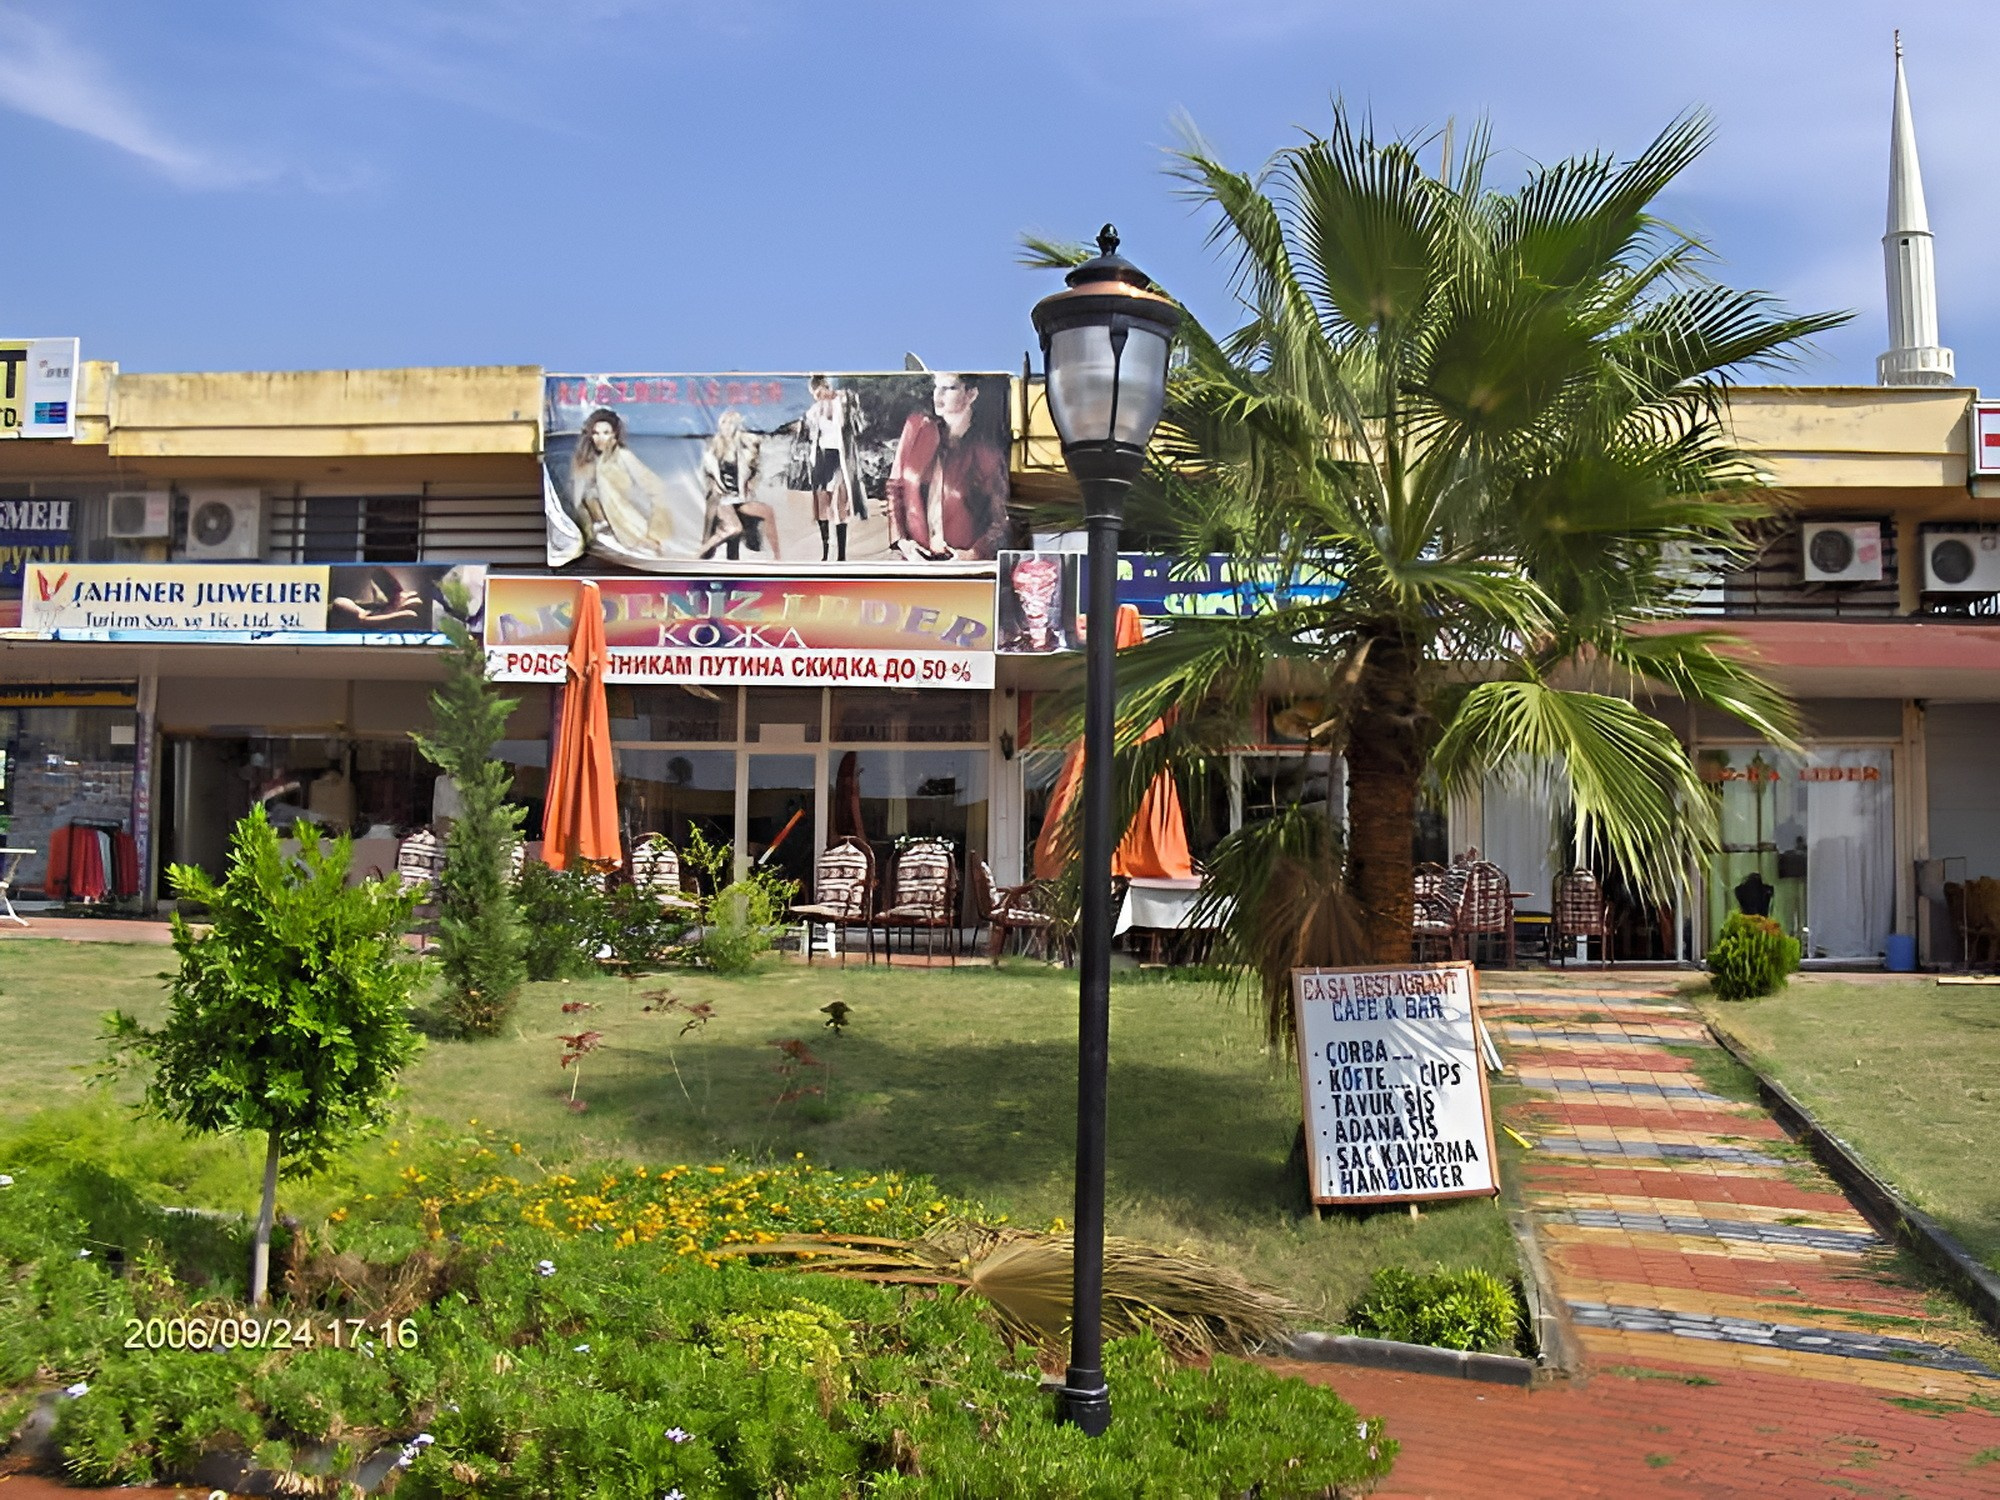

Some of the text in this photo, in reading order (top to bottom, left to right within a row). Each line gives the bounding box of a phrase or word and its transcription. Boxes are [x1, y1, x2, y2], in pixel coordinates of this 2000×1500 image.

[699, 655, 785, 678] ПУТИНА
[791, 656, 878, 681] СКИДКА
[884, 658, 916, 682] ДО
[922, 659, 947, 681] 50
[1405, 995, 1443, 1019] BAR
[1331, 1092, 1396, 1118] TAVUK
[1335, 1116, 1407, 1144] ADANA
[1380, 1139, 1479, 1170] KAVURMA
[1340, 1164, 1465, 1195] HAMBURGER
